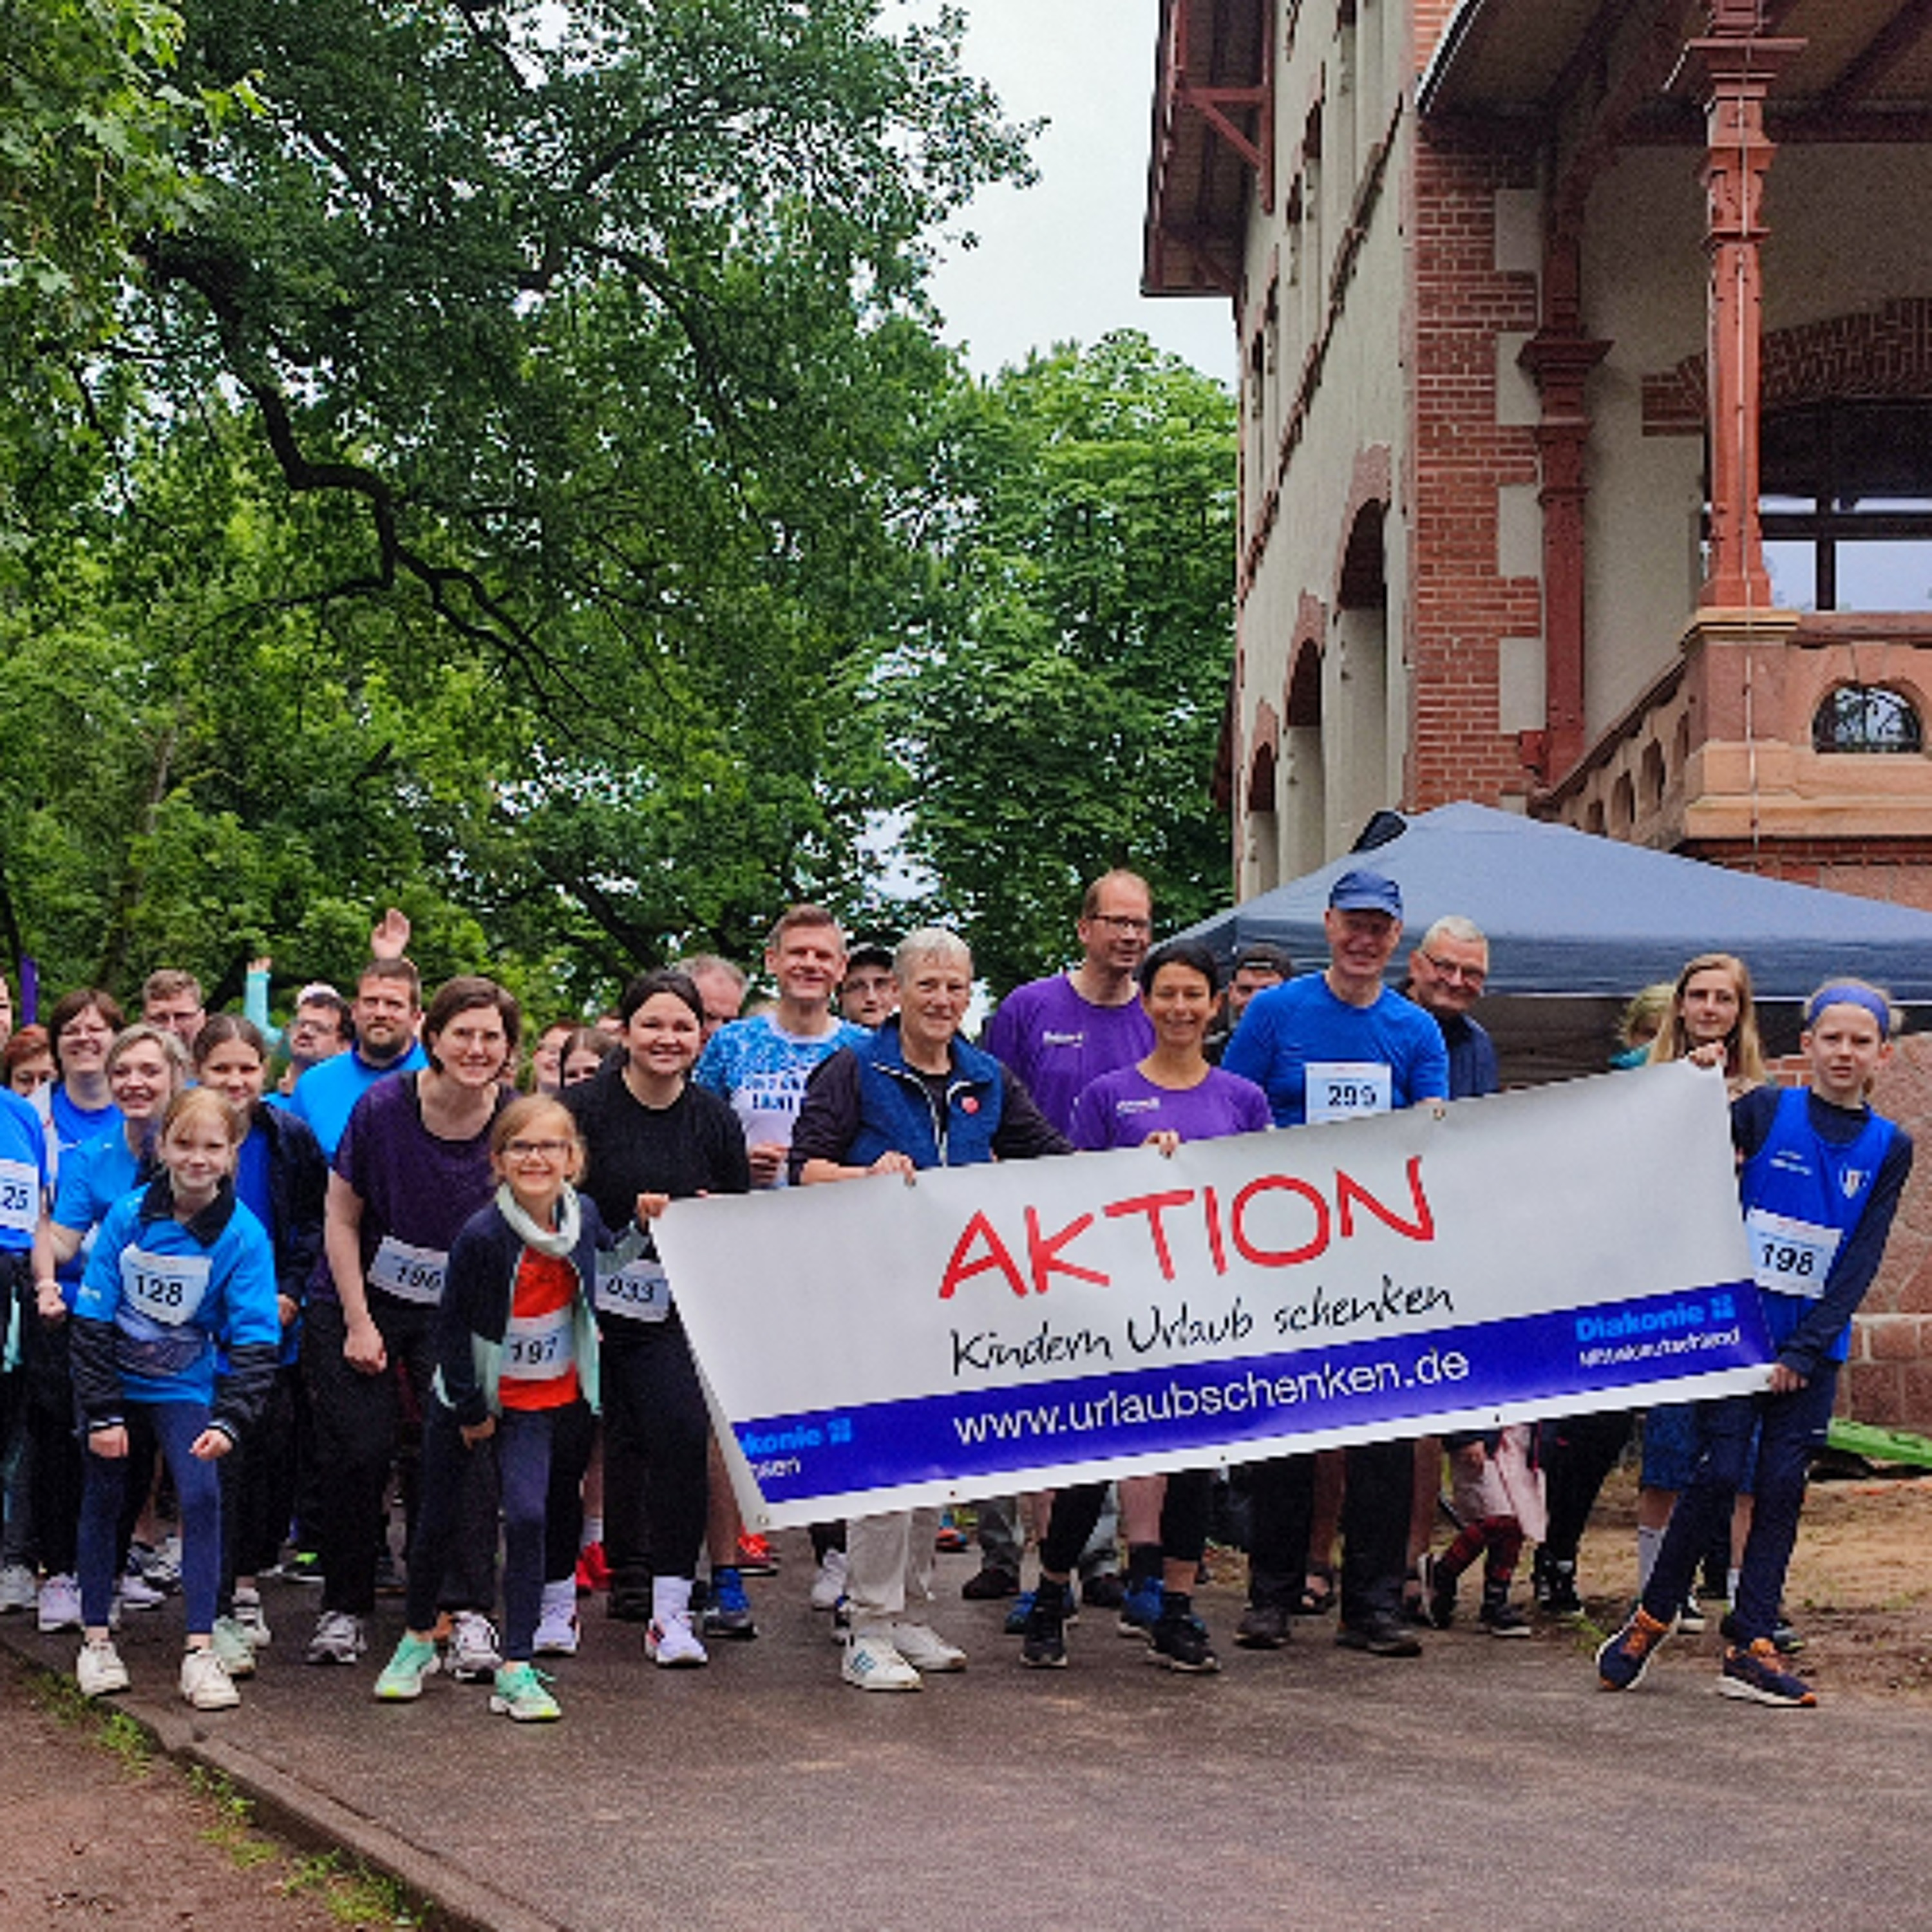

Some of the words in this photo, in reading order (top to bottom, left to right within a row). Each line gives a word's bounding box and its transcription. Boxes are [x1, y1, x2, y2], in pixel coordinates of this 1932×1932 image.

[1328, 1084, 1376, 1108] 299
[940, 1157, 1434, 1299] AKTION
[1763, 1244, 1814, 1276] 198
[136, 1274, 182, 1307] 128
[951, 1321, 1113, 1376] Kindern
[1127, 1298, 1253, 1353] Urlaub
[1274, 1275, 1454, 1334] schenken
[1576, 1302, 1705, 1341] Diakonie
[510, 1336, 558, 1364] 197
[954, 1352, 1469, 1443] www.urlaubschenken.de
